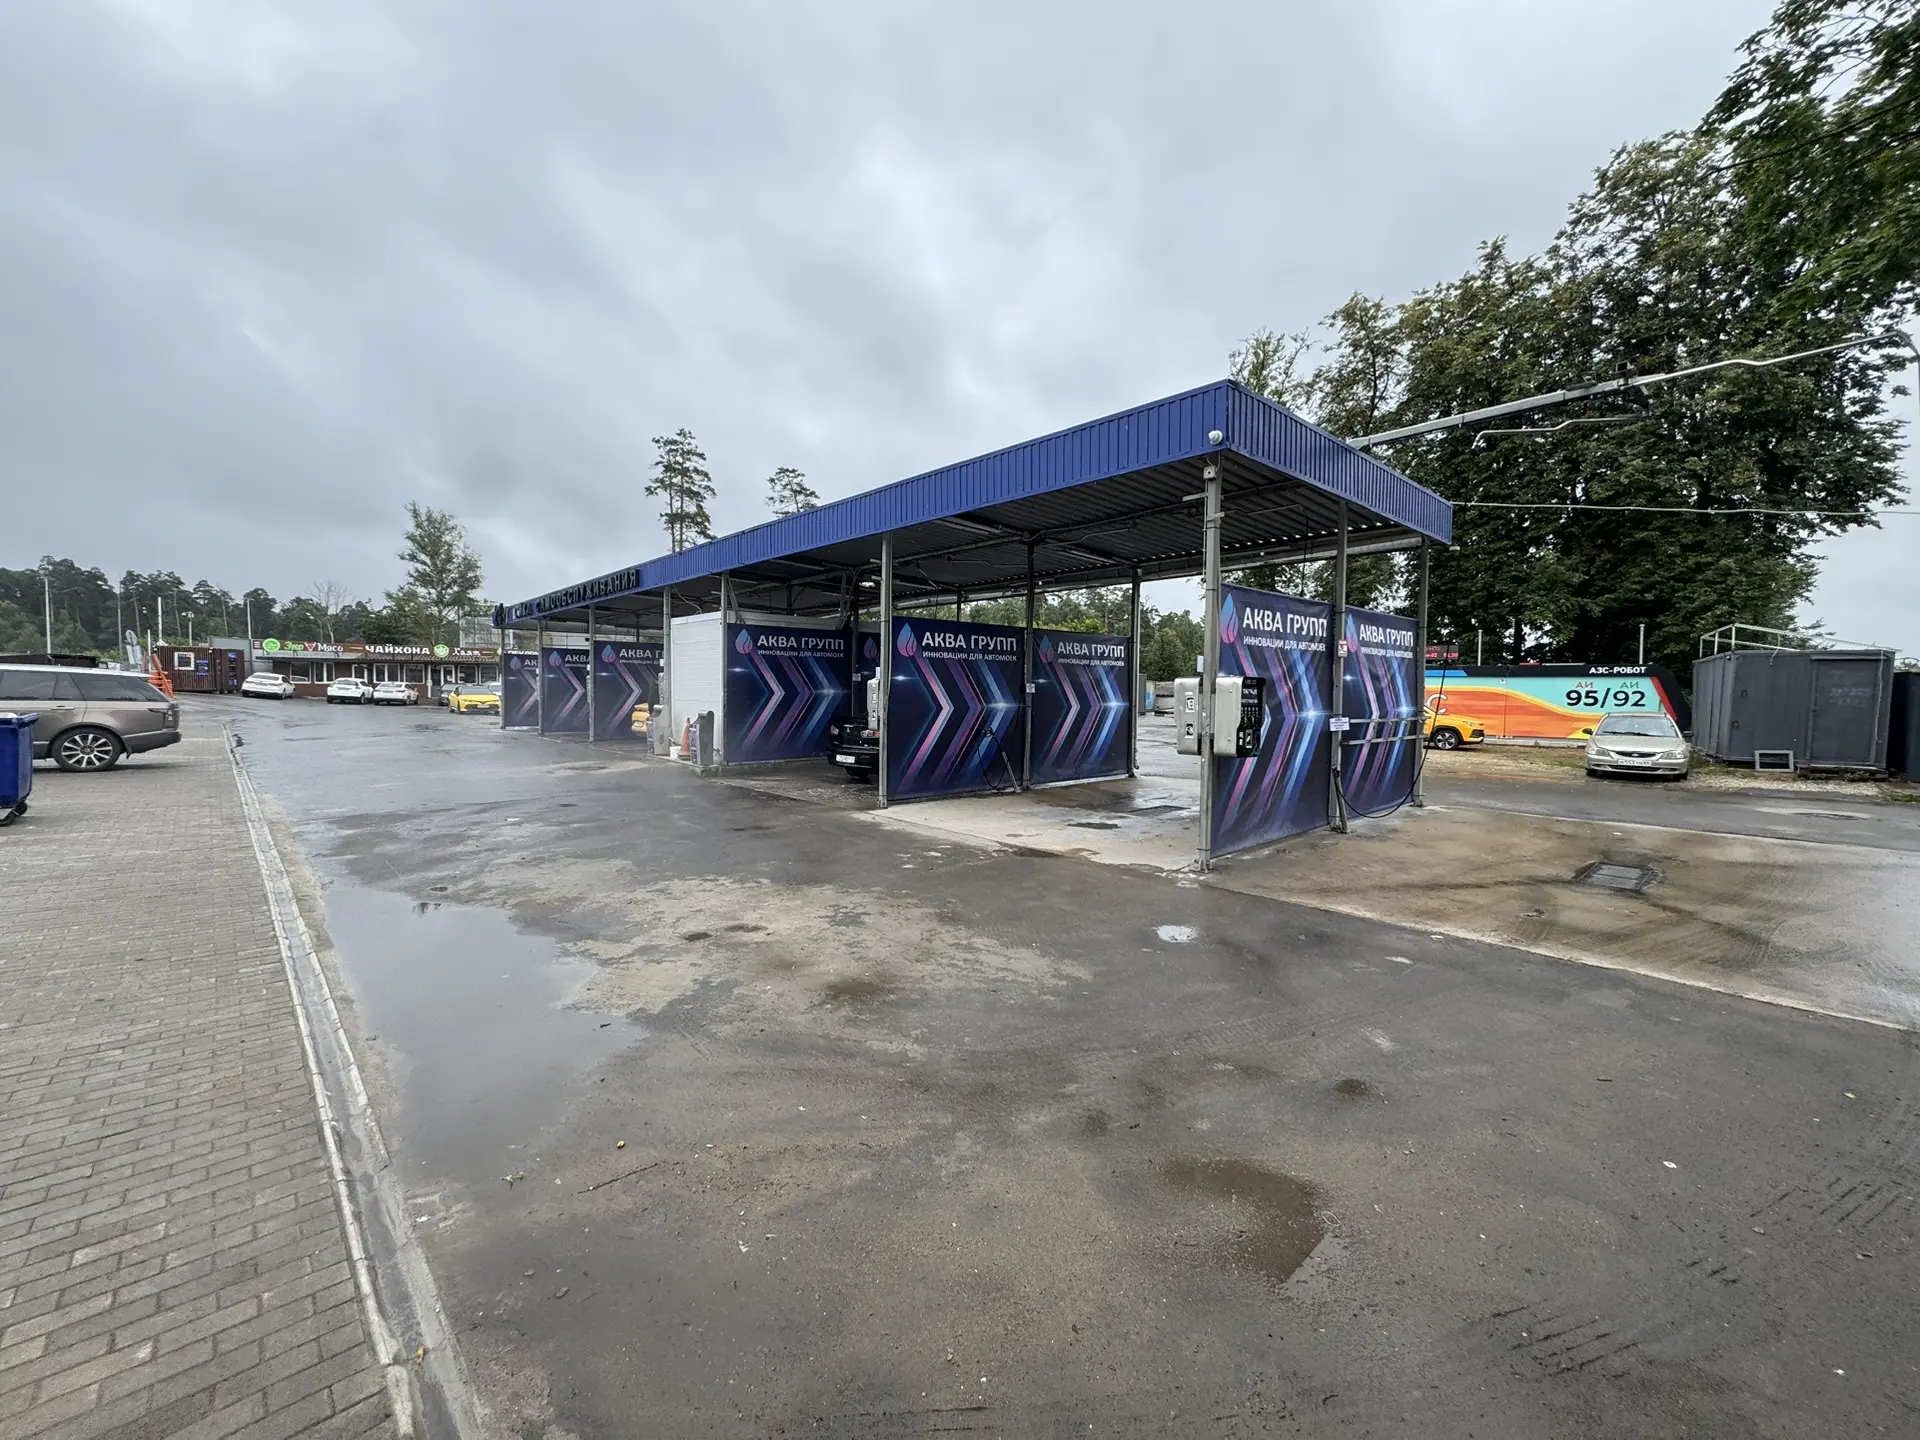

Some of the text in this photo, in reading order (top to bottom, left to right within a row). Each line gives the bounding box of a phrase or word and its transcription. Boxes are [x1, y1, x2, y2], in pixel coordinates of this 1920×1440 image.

[1242, 607, 1327, 637] АКВА ГРУПП
[922, 632, 1016, 651] АКВА ГРУПП
[1360, 624, 1413, 647] АКВА ГРУПП
[284, 641, 304, 651] Эко
[317, 643, 344, 652] Мясо
[365, 643, 430, 655] ЧАЙХОНА
[757, 635, 844, 650] АКВА ГРУПП
[1057, 641, 1124, 657] АКВА ГРУПП
[1243, 636, 1284, 648] ИННОВАЦИИ
[1284, 640, 1297, 650] ДЛЯ
[619, 649, 652, 658] АКВА
[758, 649, 797, 657] ИННОВАЦИИ
[922, 651, 967, 659] ИННОВАЦИИ
[984, 653, 1017, 661] АВТОМОЕК
[1588, 666, 1647, 674] АЗС-РОБОТ
[1575, 681, 1639, 689] АИ АИ
[1565, 687, 1646, 708] 95/92
